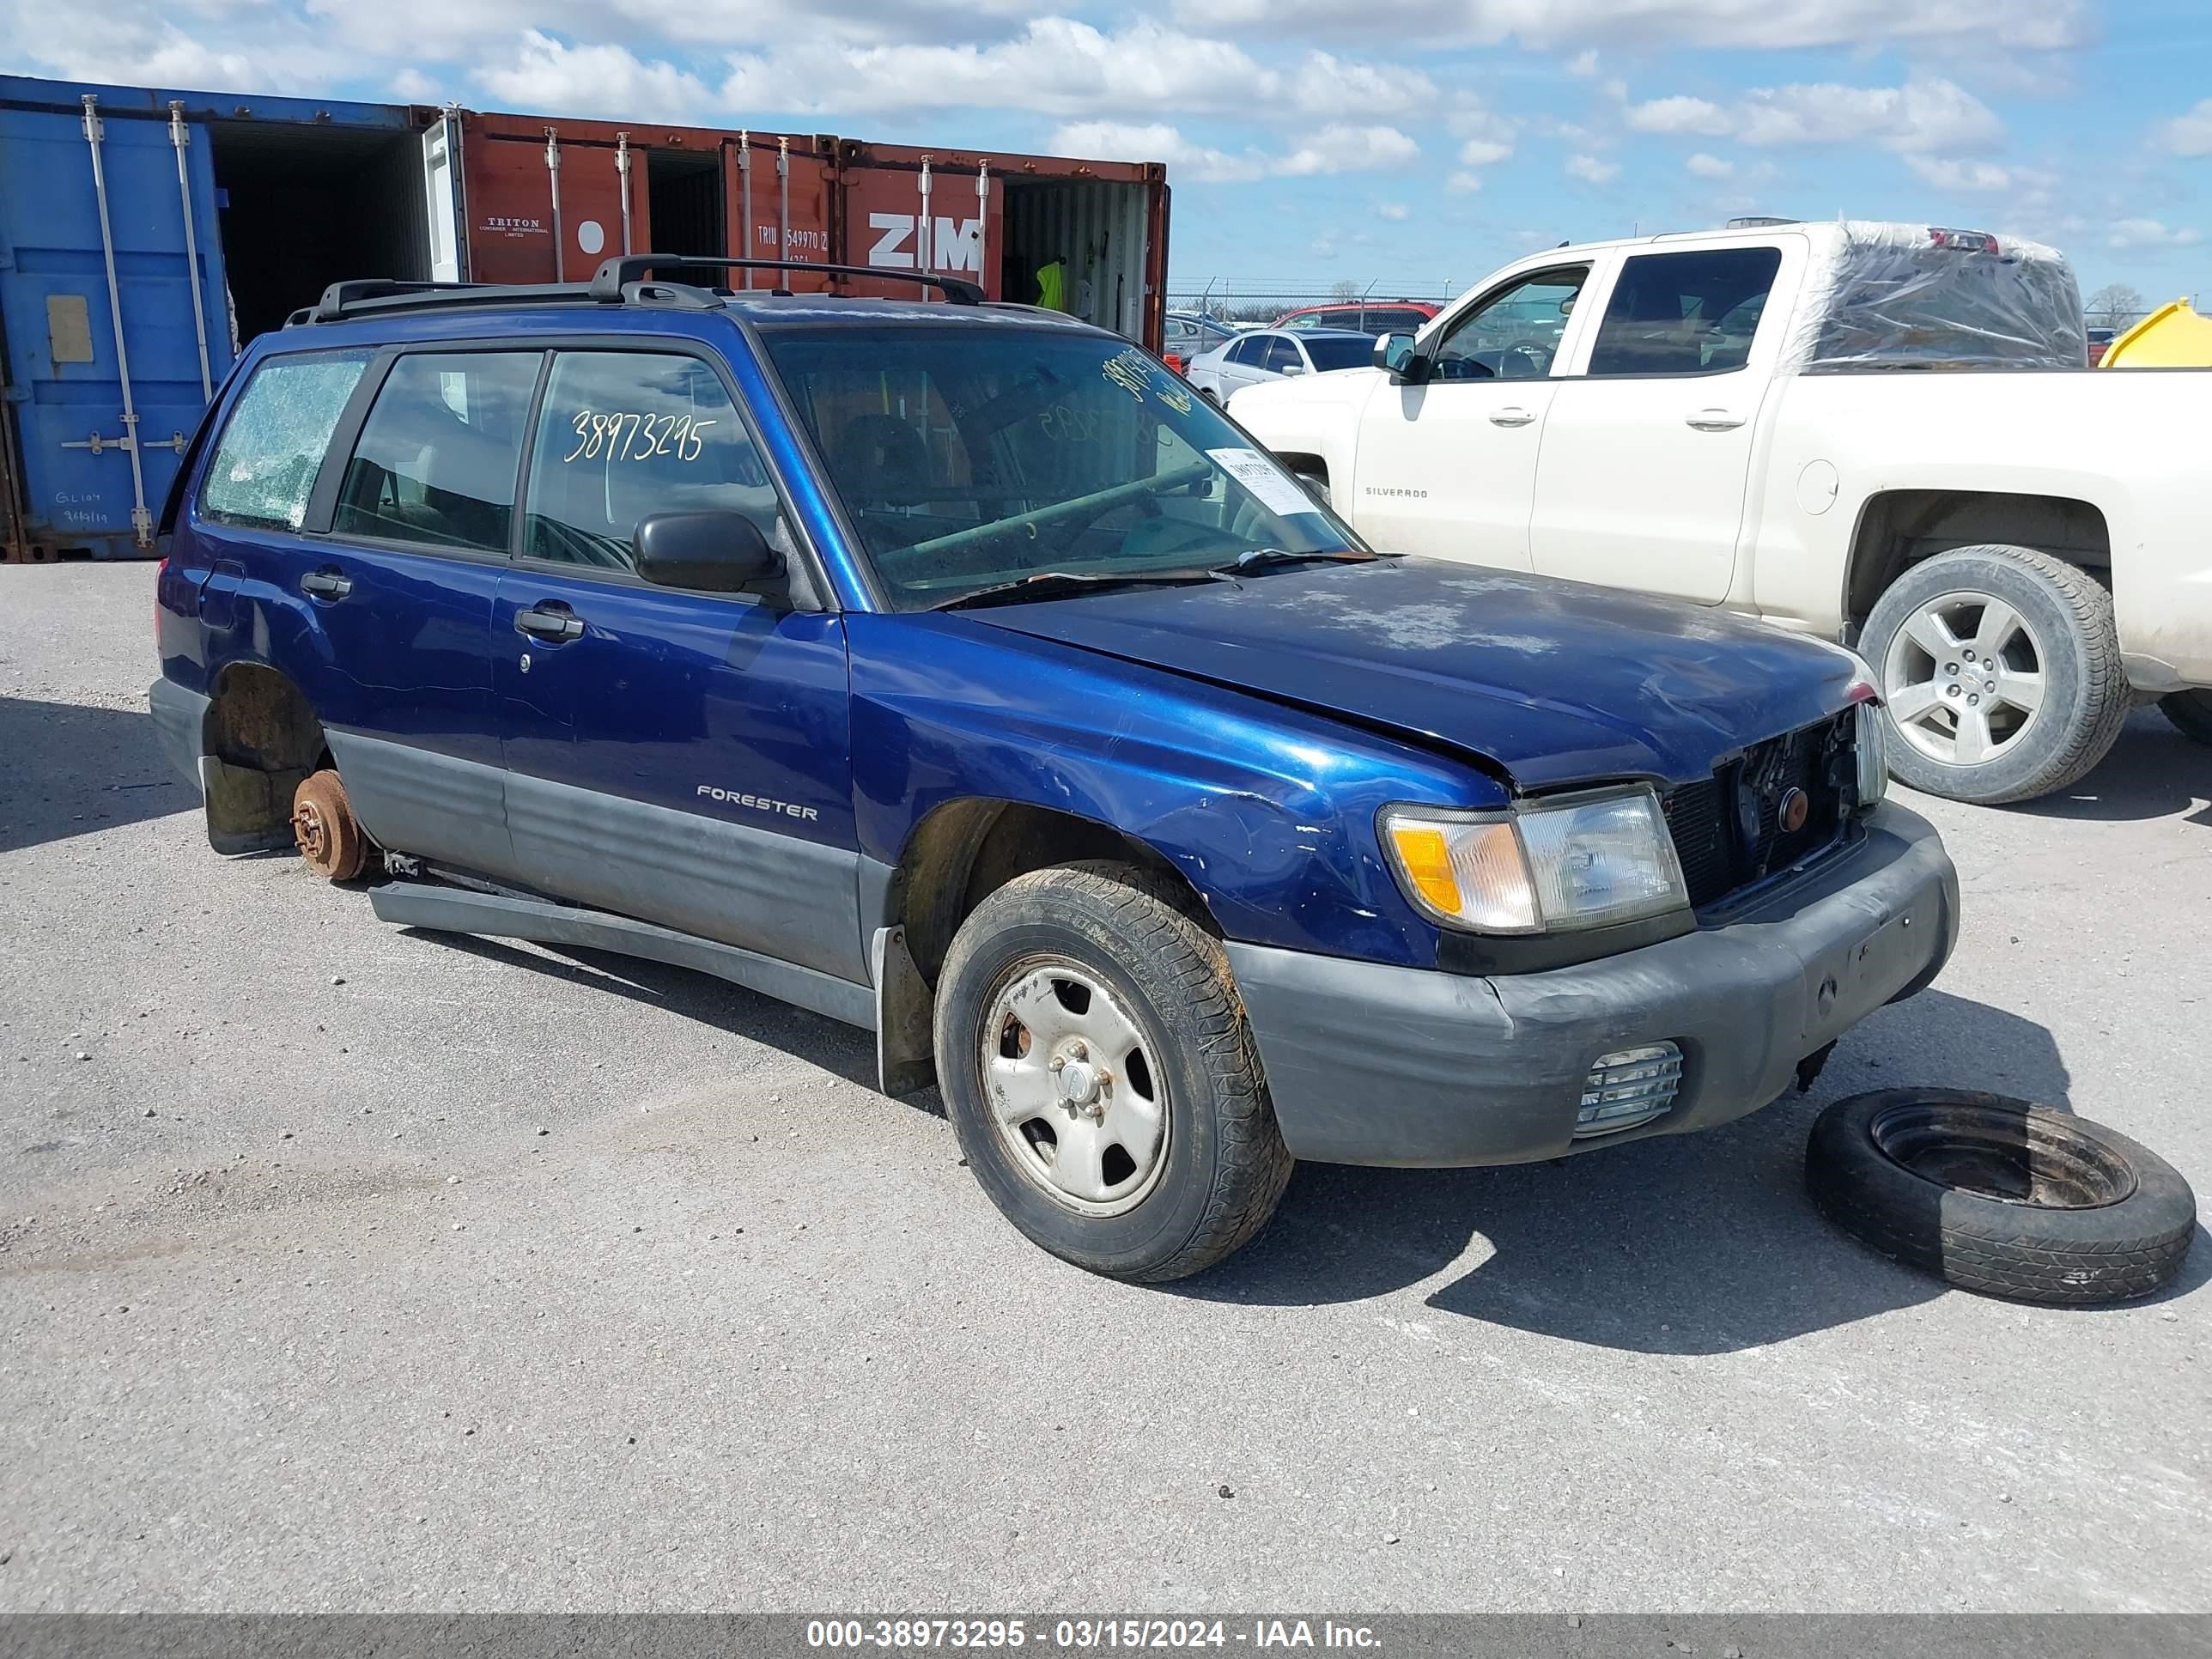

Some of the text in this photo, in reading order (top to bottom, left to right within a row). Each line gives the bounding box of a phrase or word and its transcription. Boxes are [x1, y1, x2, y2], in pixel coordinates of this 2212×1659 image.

[488, 217, 539, 228] TRITON
[758, 226, 776, 246] TRIU
[787, 228, 817, 250] 549970
[869, 212, 984, 272] ZIM
[563, 410, 718, 463] 38973295
[1366, 487, 1428, 498] SILVERADO
[696, 785, 818, 822] FORESTER
